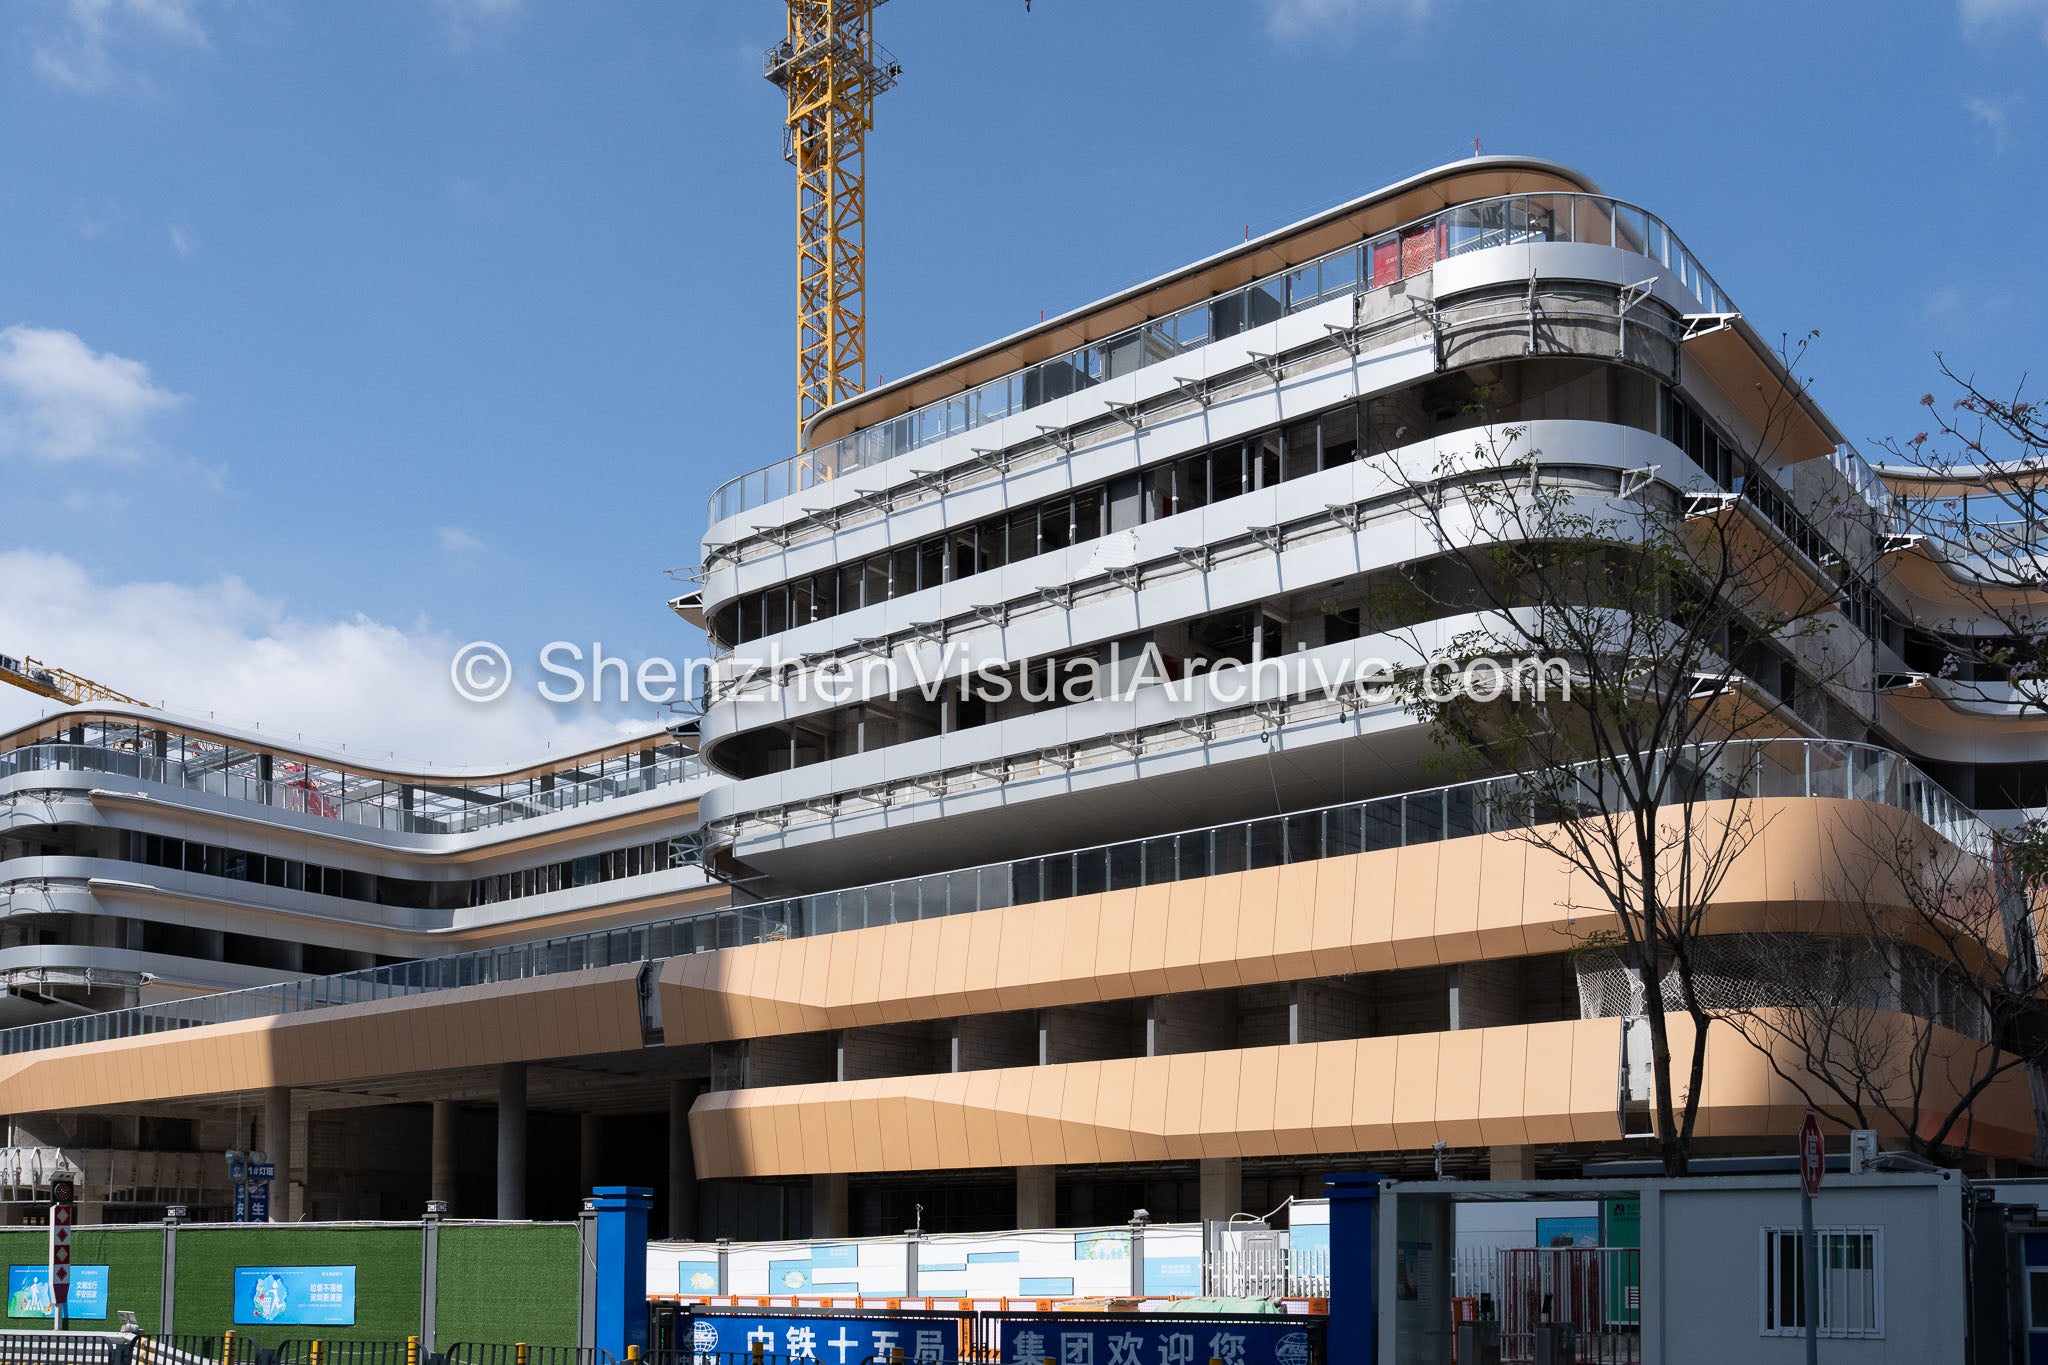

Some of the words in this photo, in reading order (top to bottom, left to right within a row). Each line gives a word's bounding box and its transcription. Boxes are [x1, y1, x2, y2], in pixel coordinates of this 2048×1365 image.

[747, 1325, 945, 1364] 中铁十五局
[1011, 1331, 1246, 1365] 集团欢迎您
